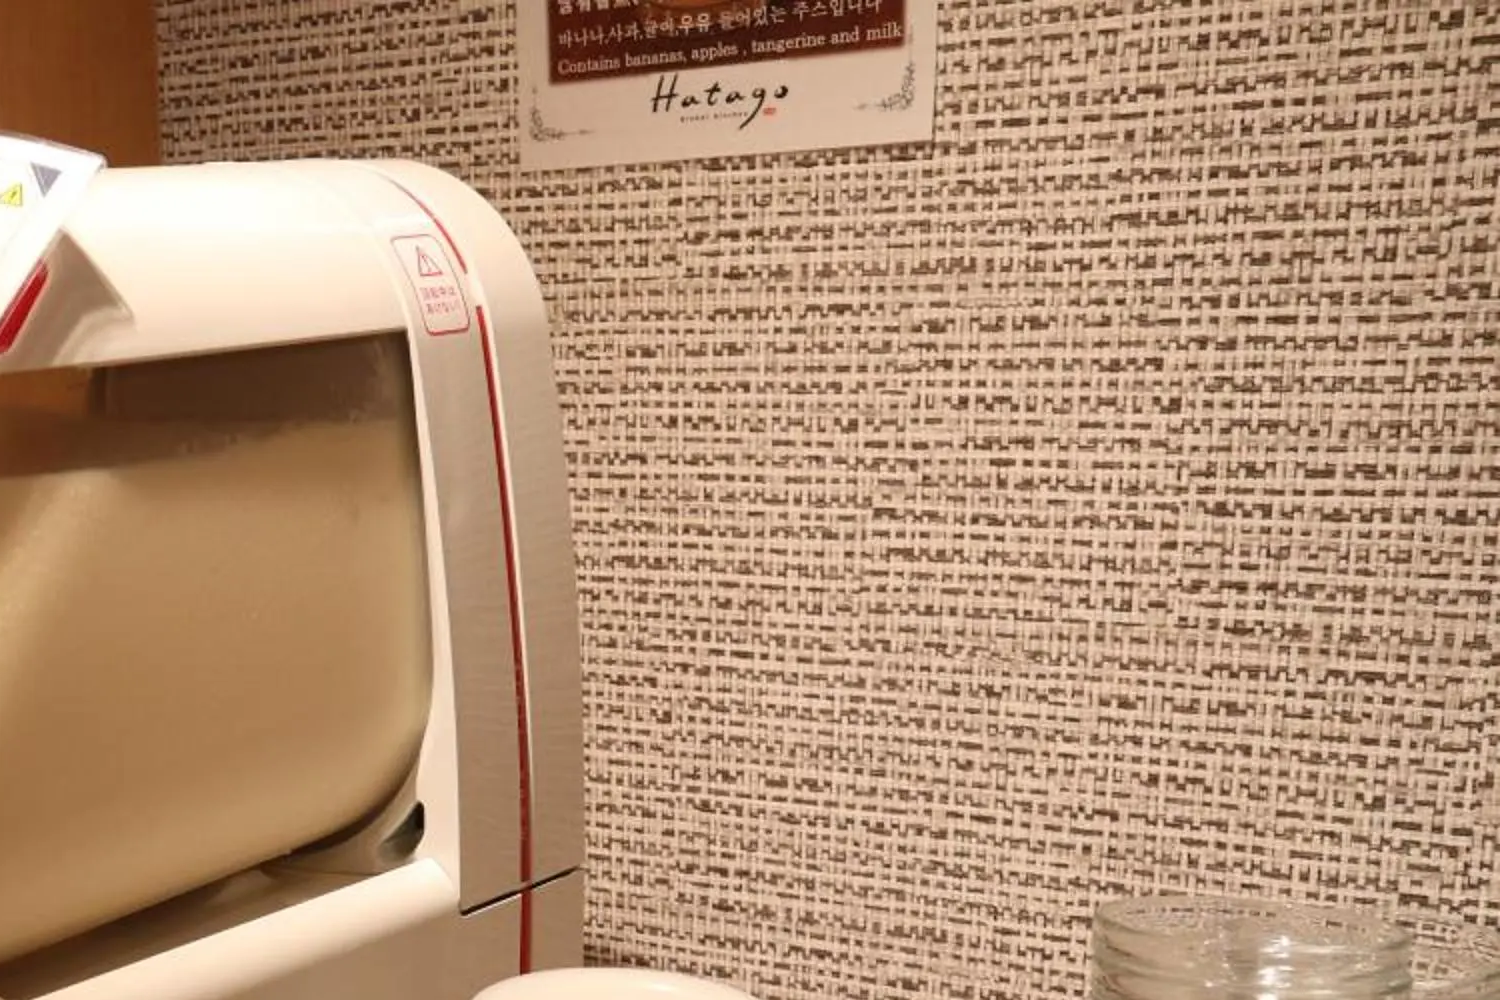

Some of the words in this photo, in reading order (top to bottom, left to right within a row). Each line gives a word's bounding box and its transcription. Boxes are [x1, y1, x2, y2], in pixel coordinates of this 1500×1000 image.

[557, 56, 621, 76] Contains
[625, 52, 687, 68] bananas,
[691, 41, 738, 62] apples
[751, 32, 826, 53] tangerine
[830, 24, 860, 45] and
[652, 72, 789, 130] Hatago
